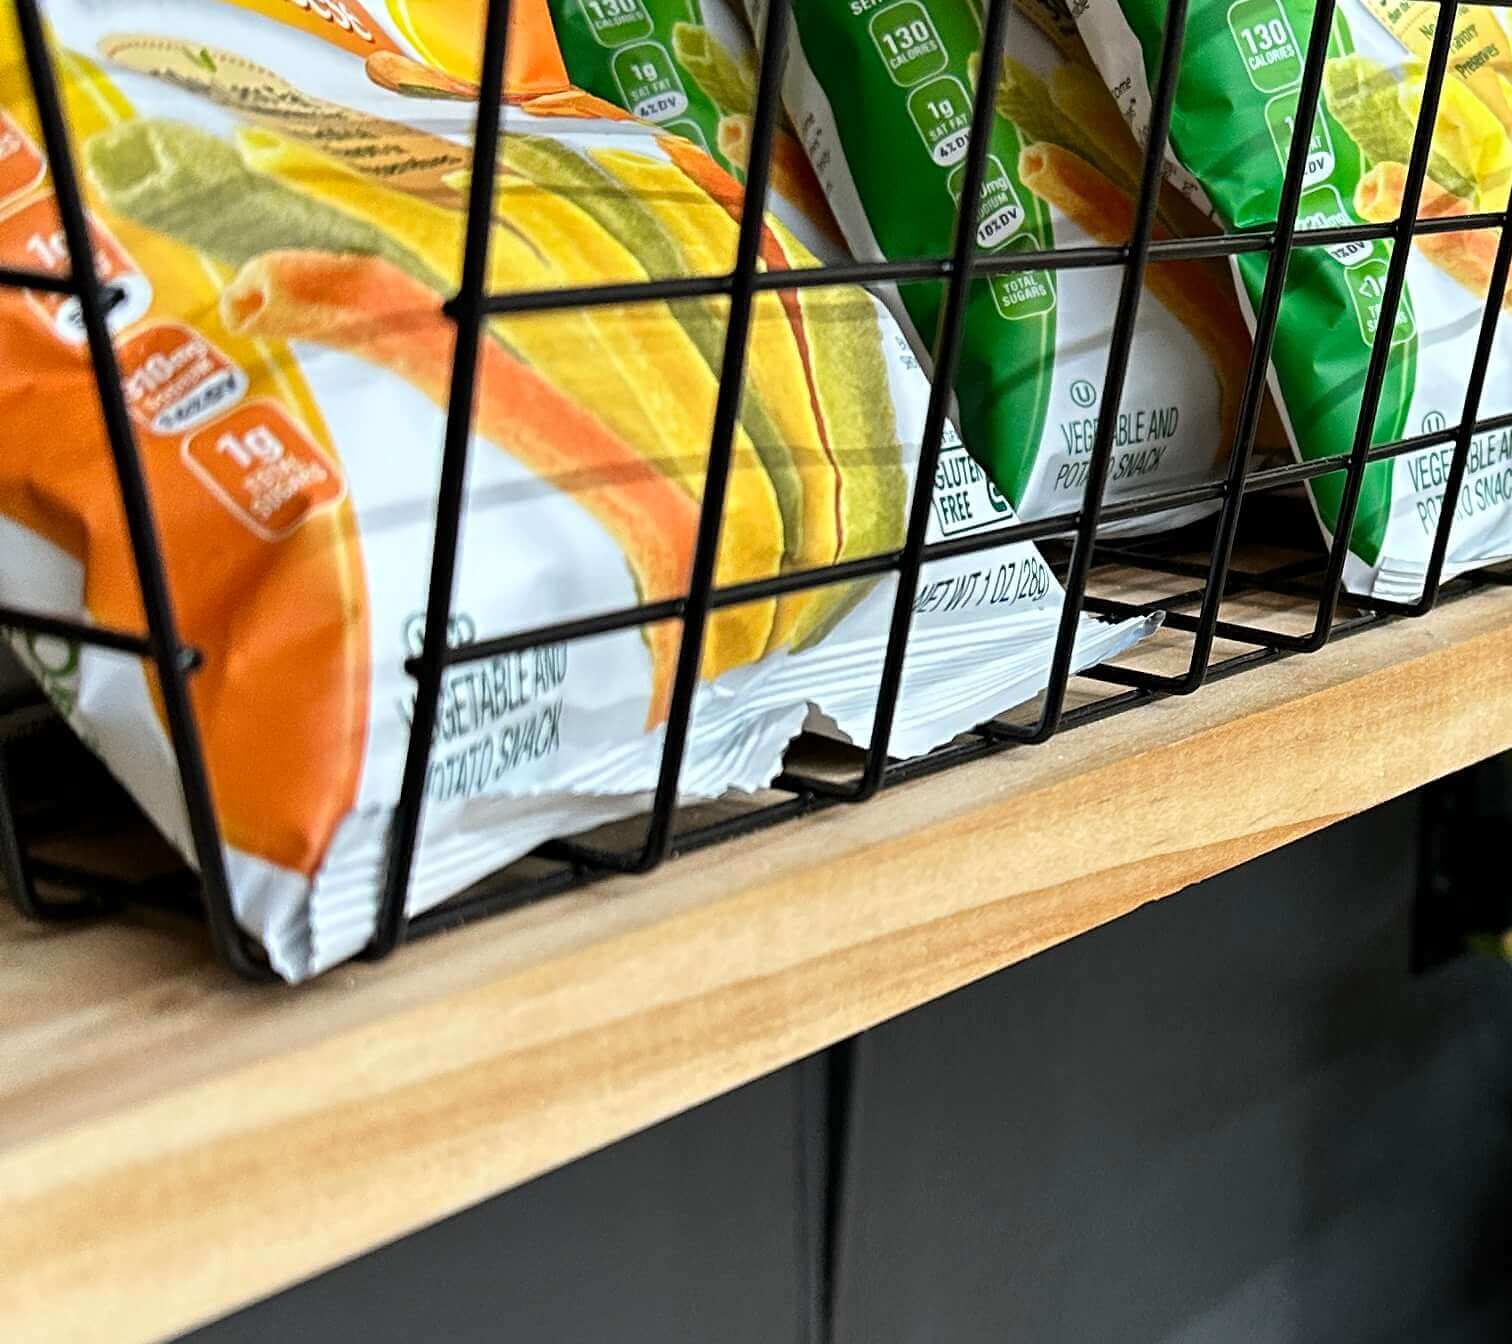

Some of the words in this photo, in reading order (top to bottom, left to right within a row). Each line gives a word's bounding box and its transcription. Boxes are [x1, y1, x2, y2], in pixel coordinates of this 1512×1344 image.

[882, 20, 930, 55] 130
[1241, 18, 1288, 55] 130
[629, 63, 659, 82] 1g
[889, 39, 938, 71] CALORIES
[1247, 43, 1296, 71] CALORIES
[927, 99, 954, 119] 1g
[928, 122, 948, 141] SAT
[948, 113, 968, 131] FAT
[1002, 284, 1047, 308] SUGARS
[1003, 274, 1038, 294] TOTAL
[1148, 406, 1179, 442] AND
[215, 425, 285, 469] 1g
[1112, 446, 1167, 482] SNACK
[938, 490, 974, 526] FREE
[943, 570, 982, 612] WT
[990, 561, 1016, 605] OZ
[494, 700, 564, 782] SNACK
